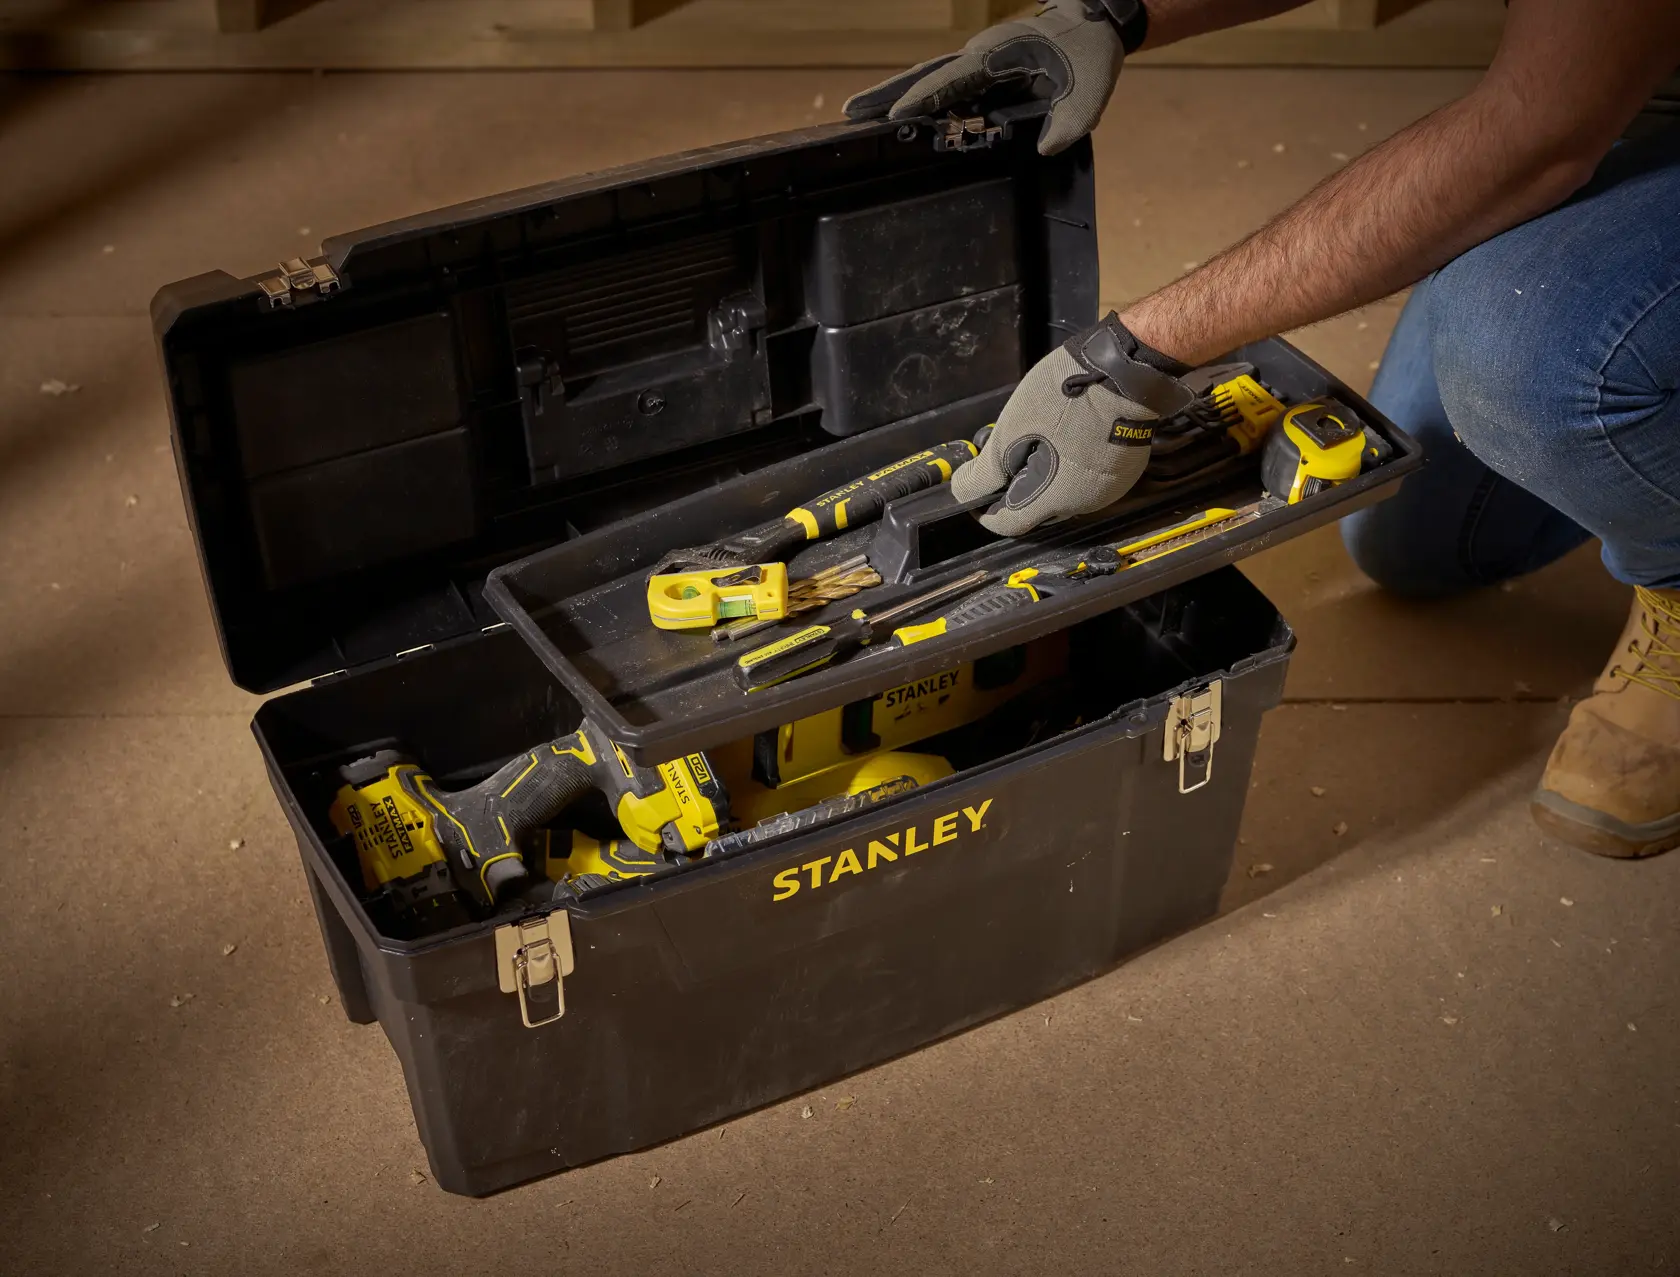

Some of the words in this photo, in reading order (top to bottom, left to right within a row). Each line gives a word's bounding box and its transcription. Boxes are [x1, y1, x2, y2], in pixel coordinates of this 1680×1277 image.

[816, 480, 865, 507] STANLEY
[875, 453, 927, 477] FATMAX
[886, 669, 960, 708] STANLEY
[664, 761, 691, 804] STANL
[690, 756, 708, 780] V20
[370, 802, 403, 859] STANLEY
[384, 798, 413, 852] FATMAX
[773, 798, 994, 902] STANLEY
